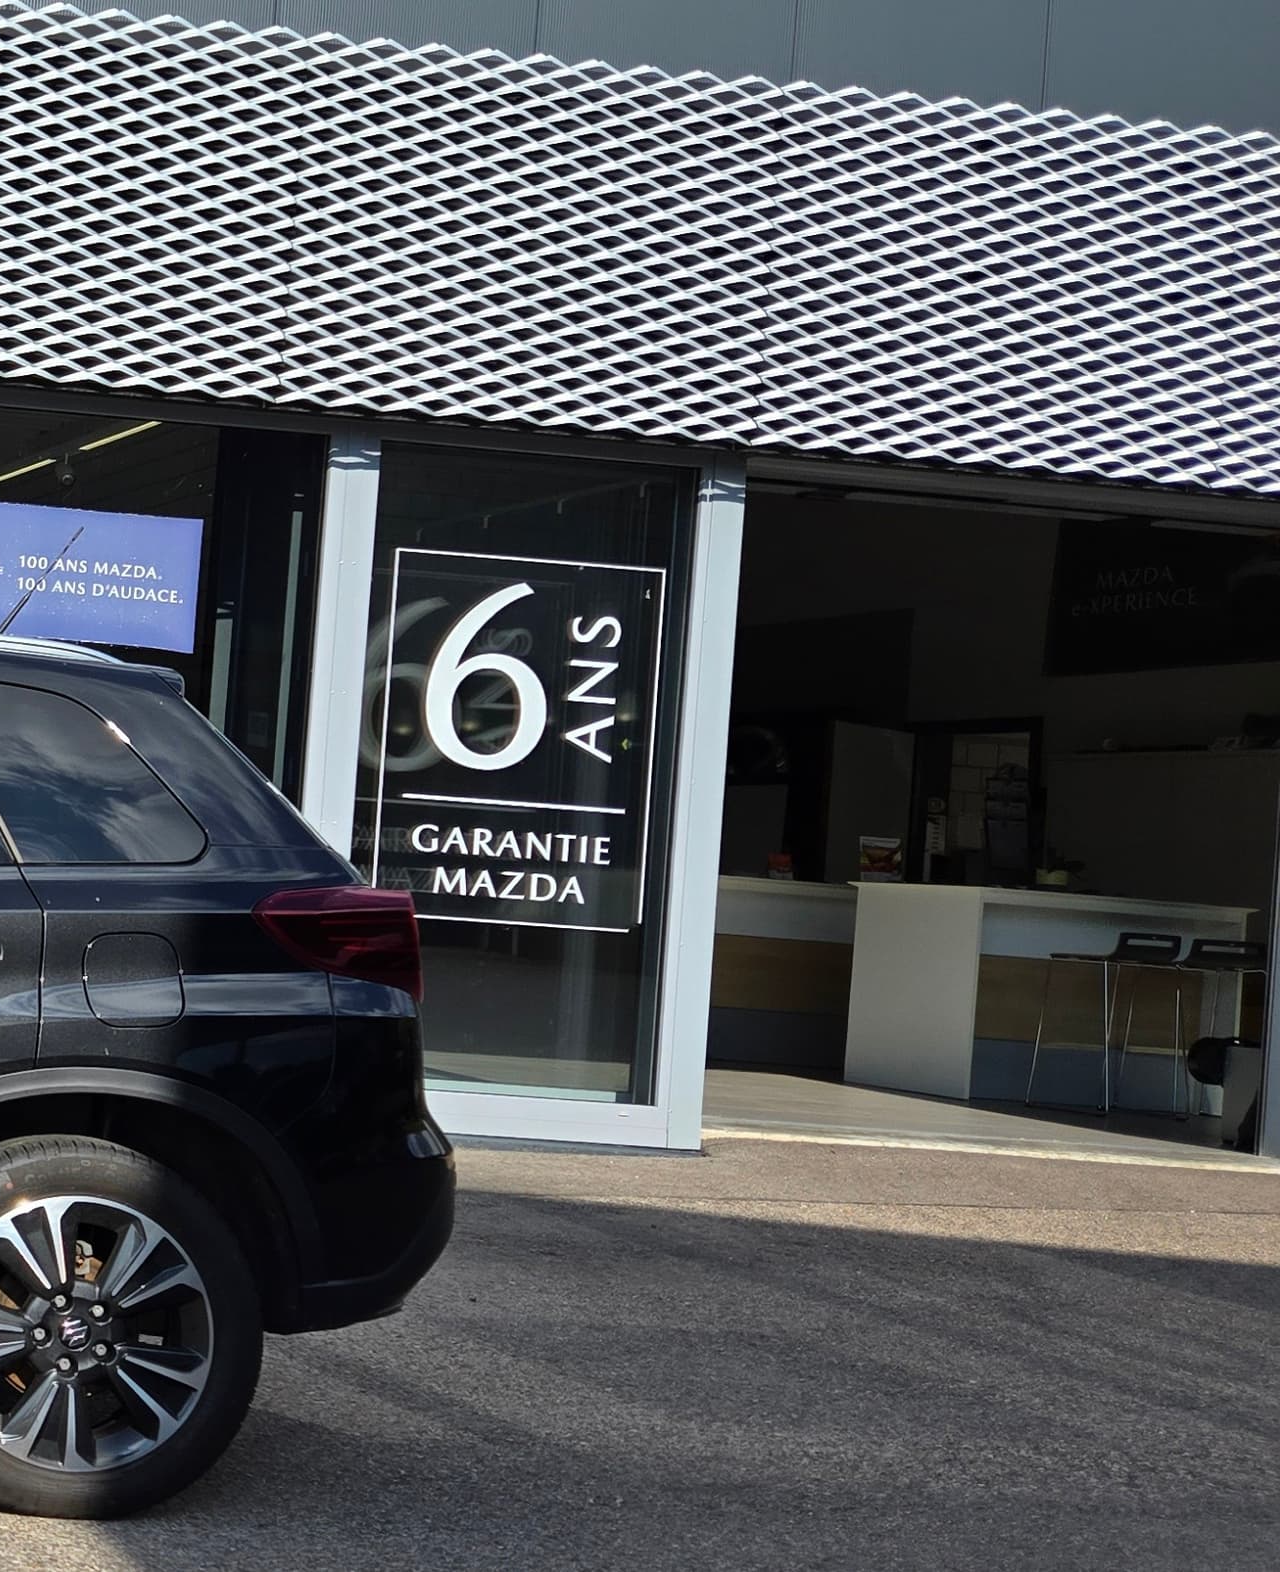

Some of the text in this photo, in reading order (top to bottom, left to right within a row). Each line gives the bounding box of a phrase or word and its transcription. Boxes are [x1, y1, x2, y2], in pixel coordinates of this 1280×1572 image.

[18, 555, 48, 570] 100
[53, 558, 88, 573] ANS
[93, 561, 163, 580] MAZDA.
[1096, 565, 1174, 590] MAZDA
[17, 577, 183, 604] 100 ANS D'AUDACE.
[425, 582, 622, 771] 6 ANS
[411, 823, 611, 866] GARANTIE
[432, 866, 584, 904] MAZDA
